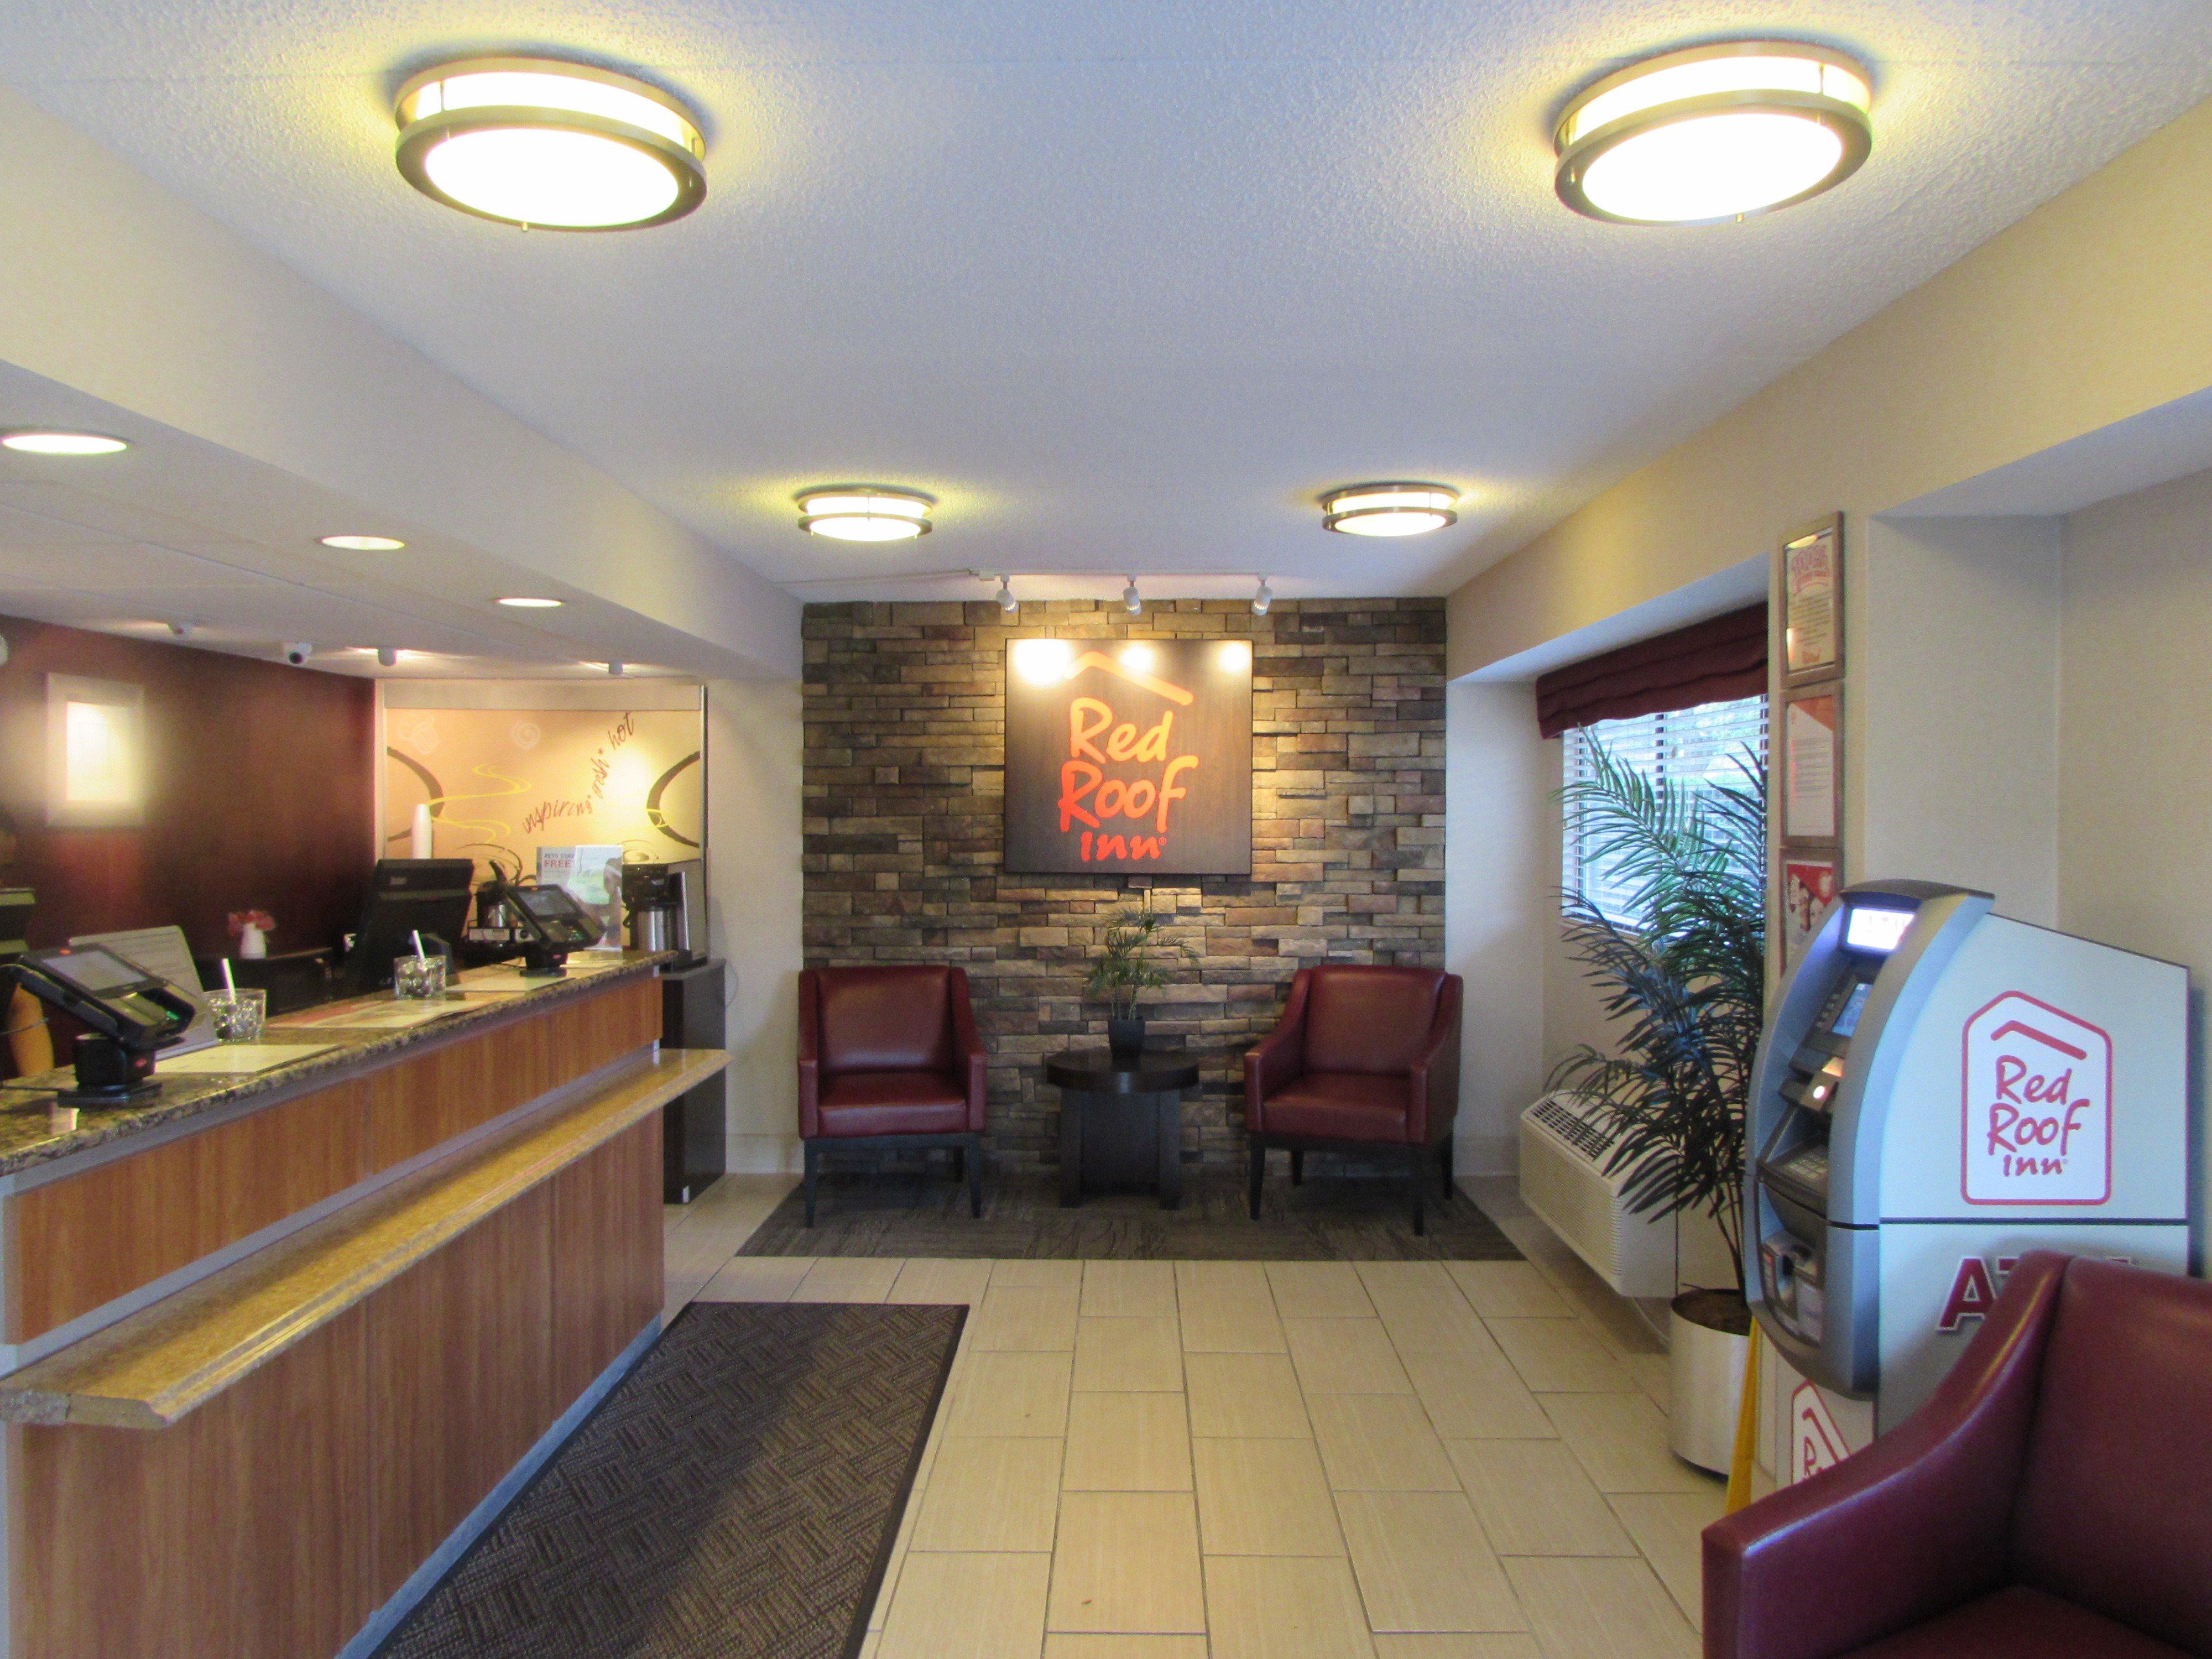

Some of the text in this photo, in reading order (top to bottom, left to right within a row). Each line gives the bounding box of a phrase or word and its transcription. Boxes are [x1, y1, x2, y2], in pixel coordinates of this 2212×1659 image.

[1070, 697, 1173, 764] Red
[1057, 755, 1199, 833] Roof
[1995, 1055, 2072, 1105] Red
[1986, 1098, 2090, 1156] Roof
